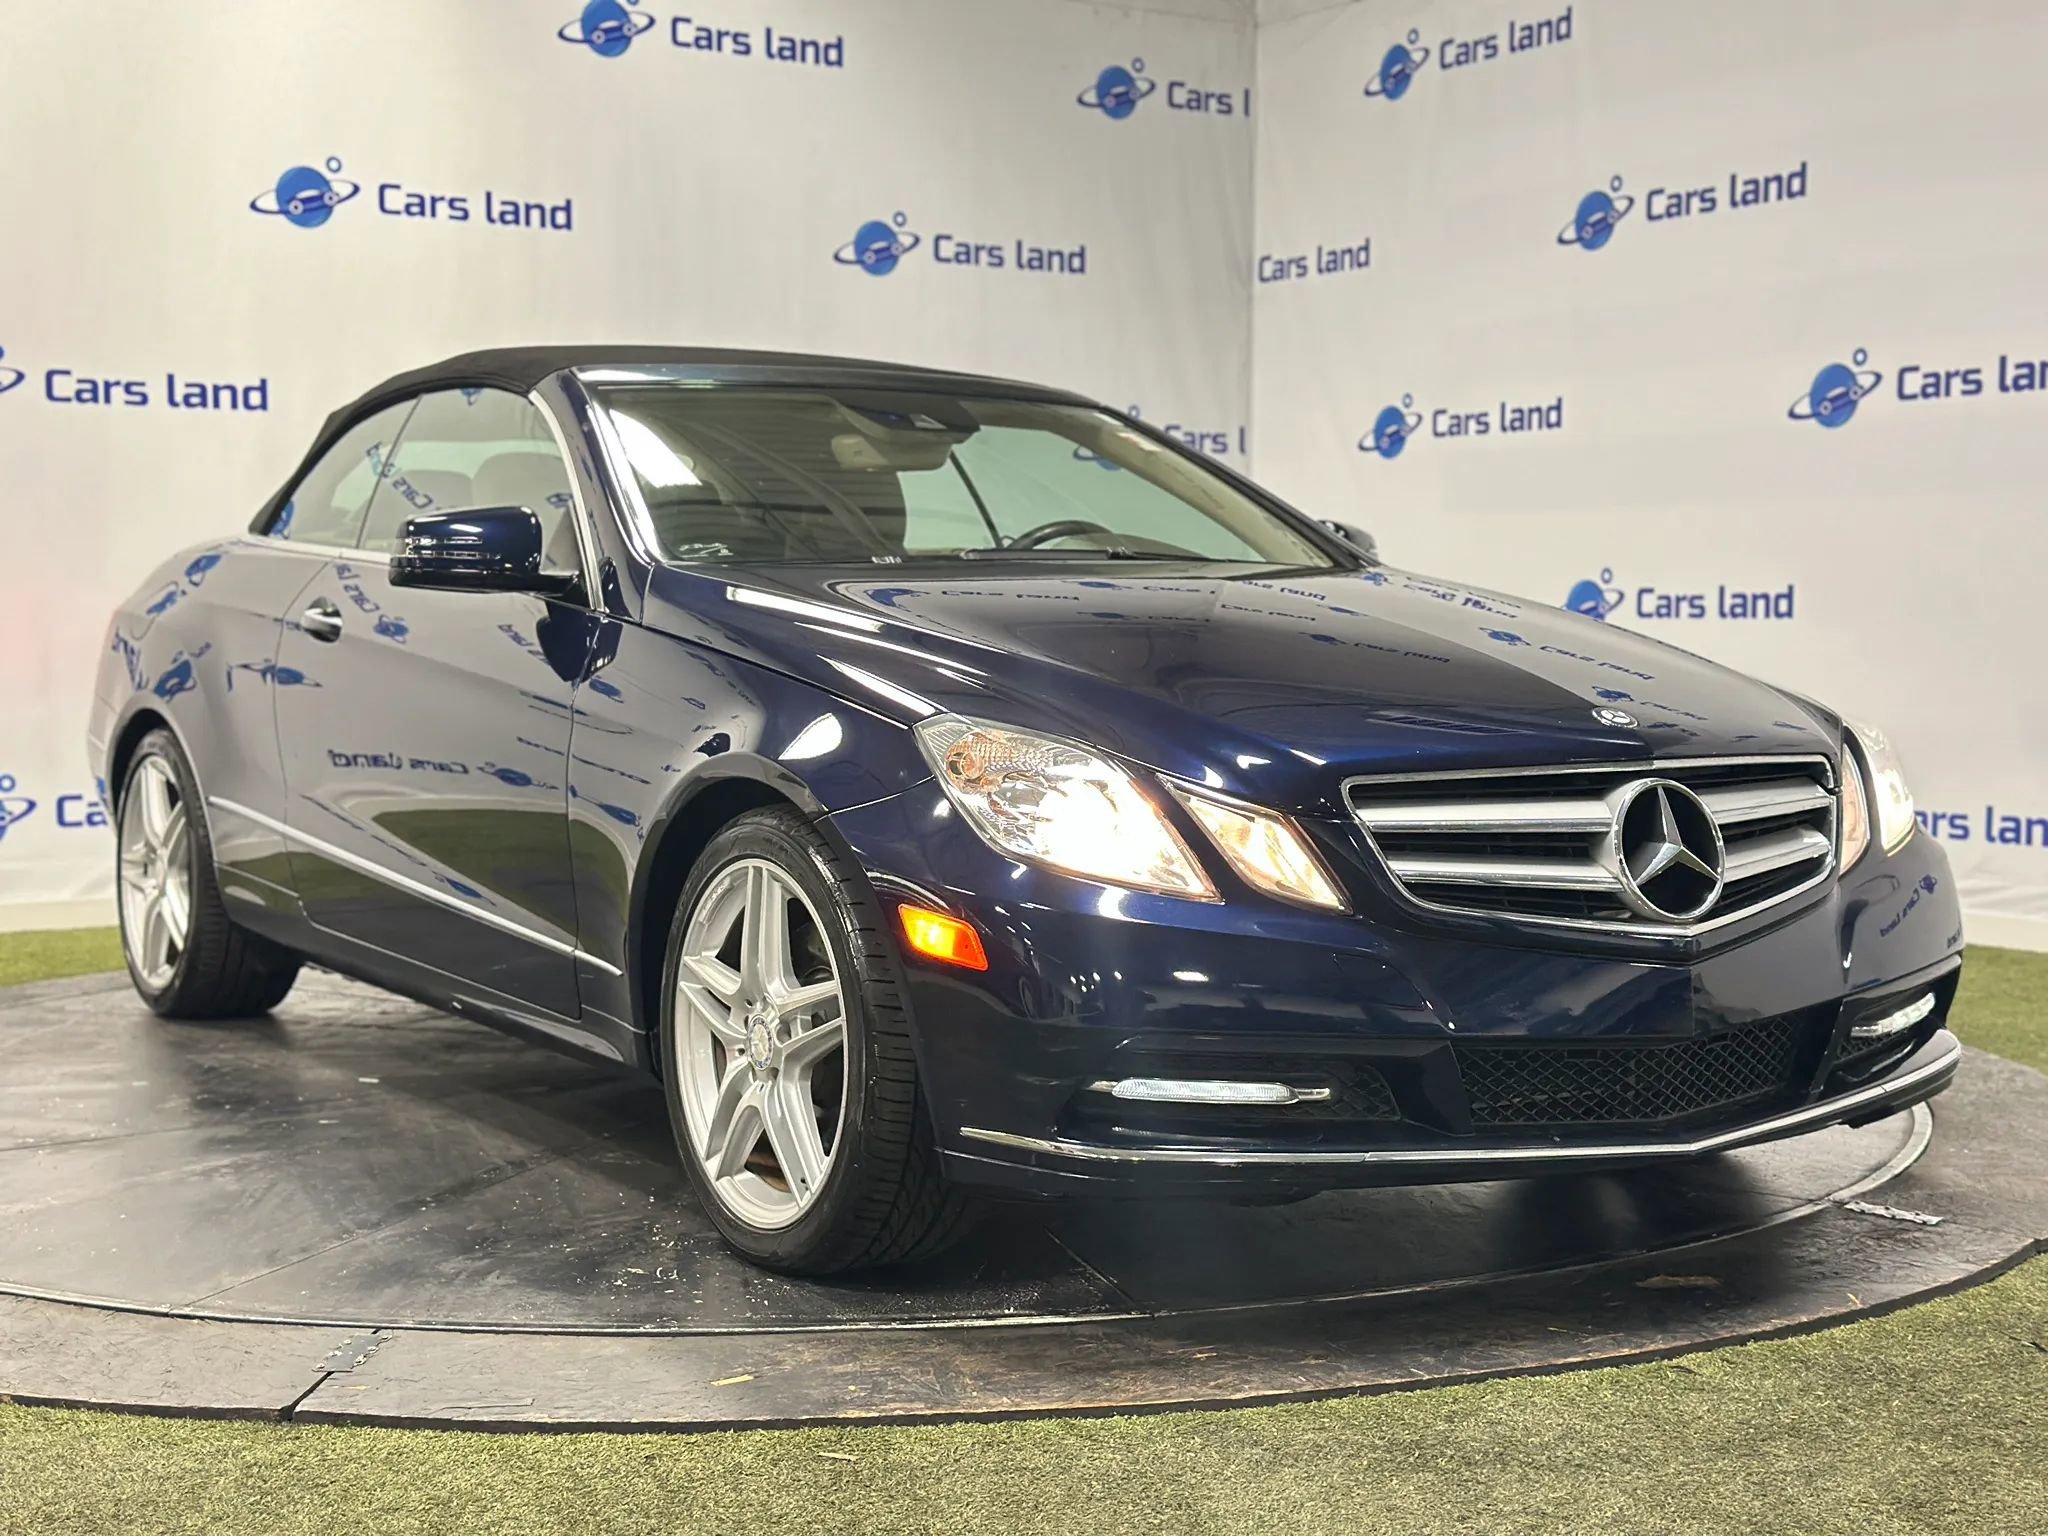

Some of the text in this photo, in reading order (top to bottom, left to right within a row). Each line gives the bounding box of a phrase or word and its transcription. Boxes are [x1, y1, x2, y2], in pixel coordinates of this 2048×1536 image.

[672, 17, 843, 67] Cars land
[1440, 6, 1573, 70] Cars land
[1168, 81, 1232, 115] Cars
[379, 184, 572, 230] Cars land
[1646, 161, 1807, 221] Cars land
[934, 234, 1085, 274] Cars land
[1258, 238, 1370, 283] Cars land
[45, 370, 267, 411] Cars land
[1897, 366, 1982, 400] Cars
[1433, 397, 1562, 437] Cars land
[1637, 585, 1794, 619] Cars land
